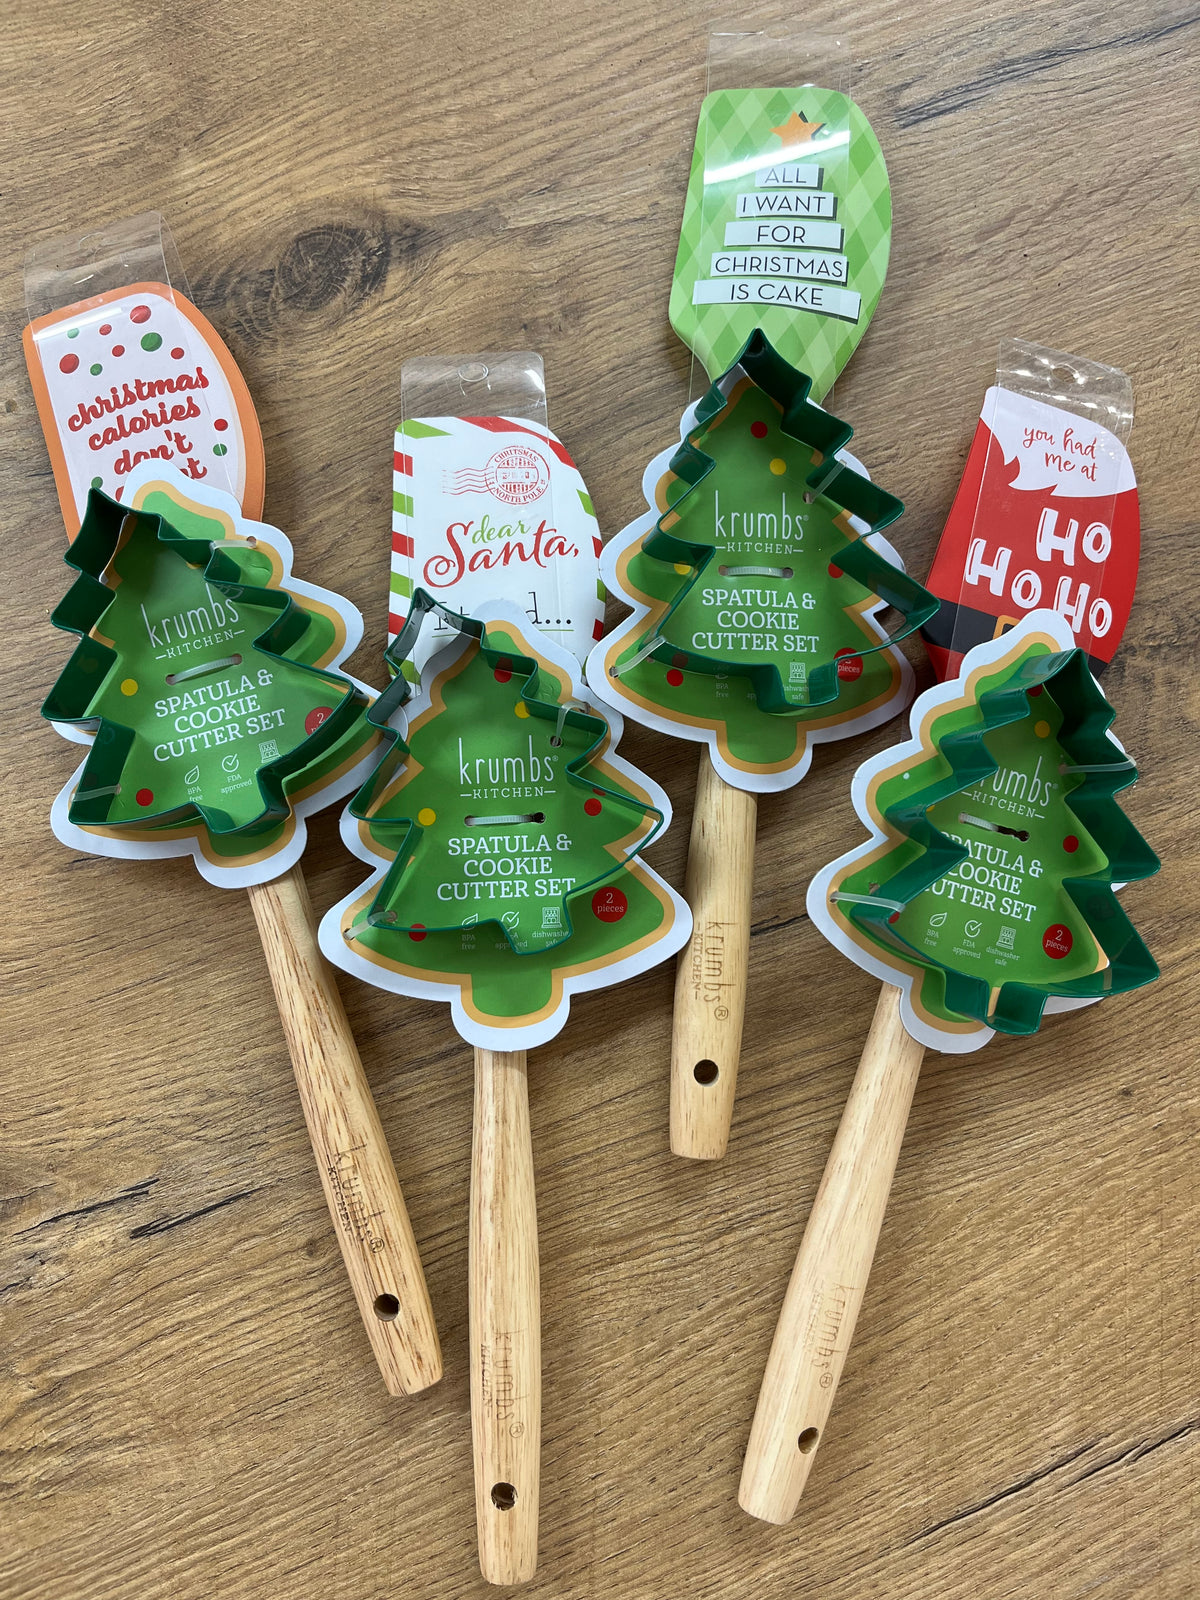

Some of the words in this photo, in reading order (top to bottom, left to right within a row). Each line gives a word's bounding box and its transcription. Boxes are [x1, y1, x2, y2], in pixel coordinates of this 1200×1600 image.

[765, 167, 807, 184] ALL
[742, 197, 747, 213] I
[755, 195, 826, 213] WANT
[757, 225, 806, 243] FOR
[715, 256, 843, 278] CHRISTMAS
[730, 284, 749, 301] IS
[757, 283, 824, 306] CAKE
[68, 367, 209, 432] christmas
[89, 396, 200, 451] calories
[1022, 427, 1055, 449] you
[1063, 428, 1098, 459] had
[1045, 452, 1076, 473] me
[1080, 463, 1098, 482] at
[493, 488, 521, 502] NORTH
[523, 487, 543, 501] POLE
[472, 515, 531, 544] dear
[1036, 507, 1112, 566] HO
[423, 520, 579, 587] Santa,
[727, 542, 793, 555] KITCHEN
[702, 589, 798, 609] SPATULA
[802, 593, 816, 610] &
[141, 582, 239, 648] krumbs
[717, 611, 800, 631] COOKIE
[166, 629, 234, 658] KITCHEN
[692, 632, 778, 652] CUTTER
[783, 634, 820, 653] SET
[154, 675, 255, 718] SPATULA
[257, 669, 273, 686] &
[174, 694, 261, 733] COOKIE
[153, 722, 246, 762] CUTTER
[248, 709, 286, 735] SET
[220, 779, 253, 794] approved
[227, 774, 242, 782] FDA
[187, 787, 201, 795] BPA
[473, 787, 544, 799] KITCHEN
[972, 790, 1036, 818] KITCHEN
[448, 834, 555, 855] SPATULA
[556, 834, 572, 851] &
[463, 857, 552, 877] COOKIE
[1028, 859, 1044, 879] &
[437, 880, 533, 900] CUTTER
[534, 878, 576, 896] SET
[606, 892, 613, 904] 2
[597, 903, 624, 914] pieces
[925, 878, 997, 912] UTTER
[999, 898, 1037, 922] SET
[532, 930, 569, 938] dishwashe
[923, 936, 938, 947] free
[926, 928, 939, 939] BPA
[1054, 929, 1063, 942] 2
[952, 945, 981, 959] approved
[1044, 939, 1069, 953] pieces
[692, 933, 703, 990] KITCHEN
